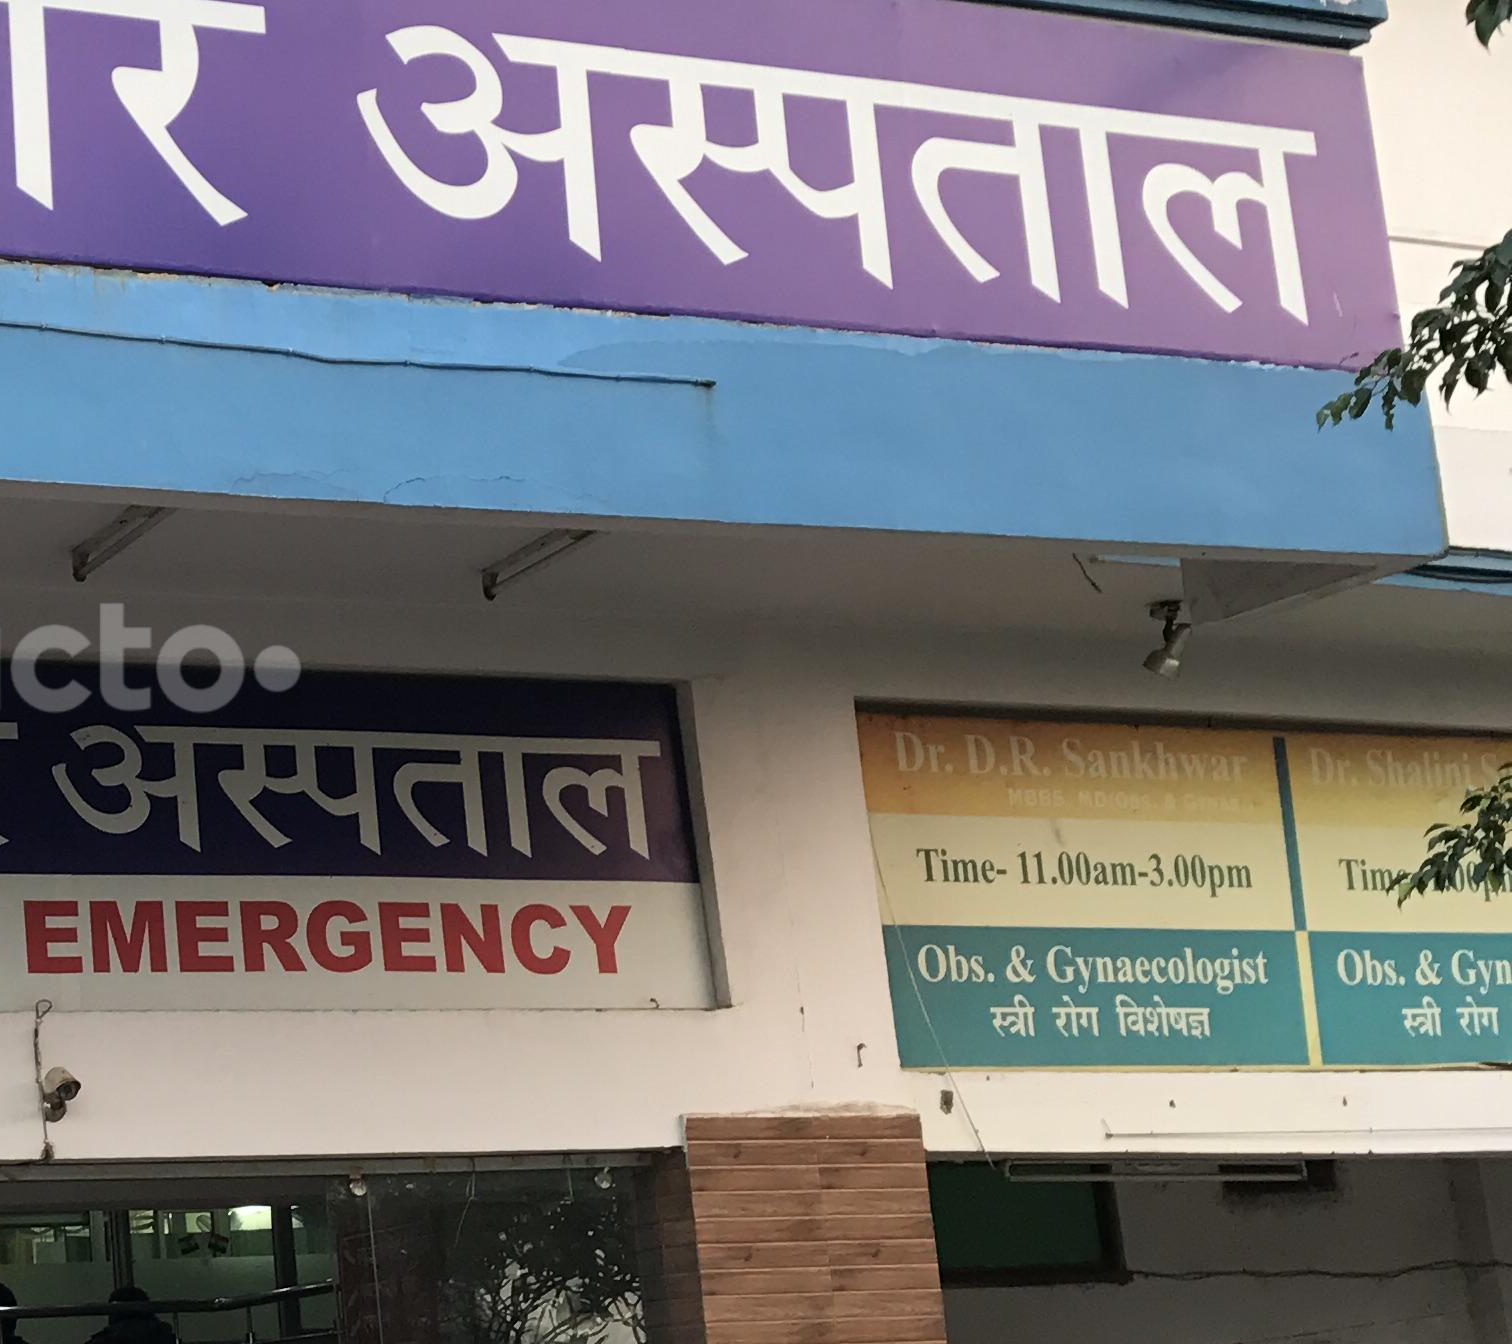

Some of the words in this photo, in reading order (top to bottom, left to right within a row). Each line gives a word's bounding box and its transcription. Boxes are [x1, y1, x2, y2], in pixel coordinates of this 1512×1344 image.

[357, 24, 1316, 330] अस्पताल
[894, 731, 953, 773] Dr.
[1062, 736, 1249, 782] Sankhwar
[1309, 747, 1357, 786] Dr.
[52, 725, 661, 859] अस्पताल
[25, 899, 632, 977] EMERGENCY
[918, 943, 995, 984] Obs.
[1005, 945, 1036, 985] &
[1046, 945, 1268, 995] Gynaecologist
[1337, 948, 1406, 986] Obs.
[1415, 950, 1443, 986] &
[990, 994, 1035, 1038] स्त्री
[1052, 996, 1099, 1038] रोग
[1115, 994, 1211, 1039] विशेषज्ञ
[1402, 996, 1442, 1038] स्त्री
[1456, 997, 1500, 1038] रोग
